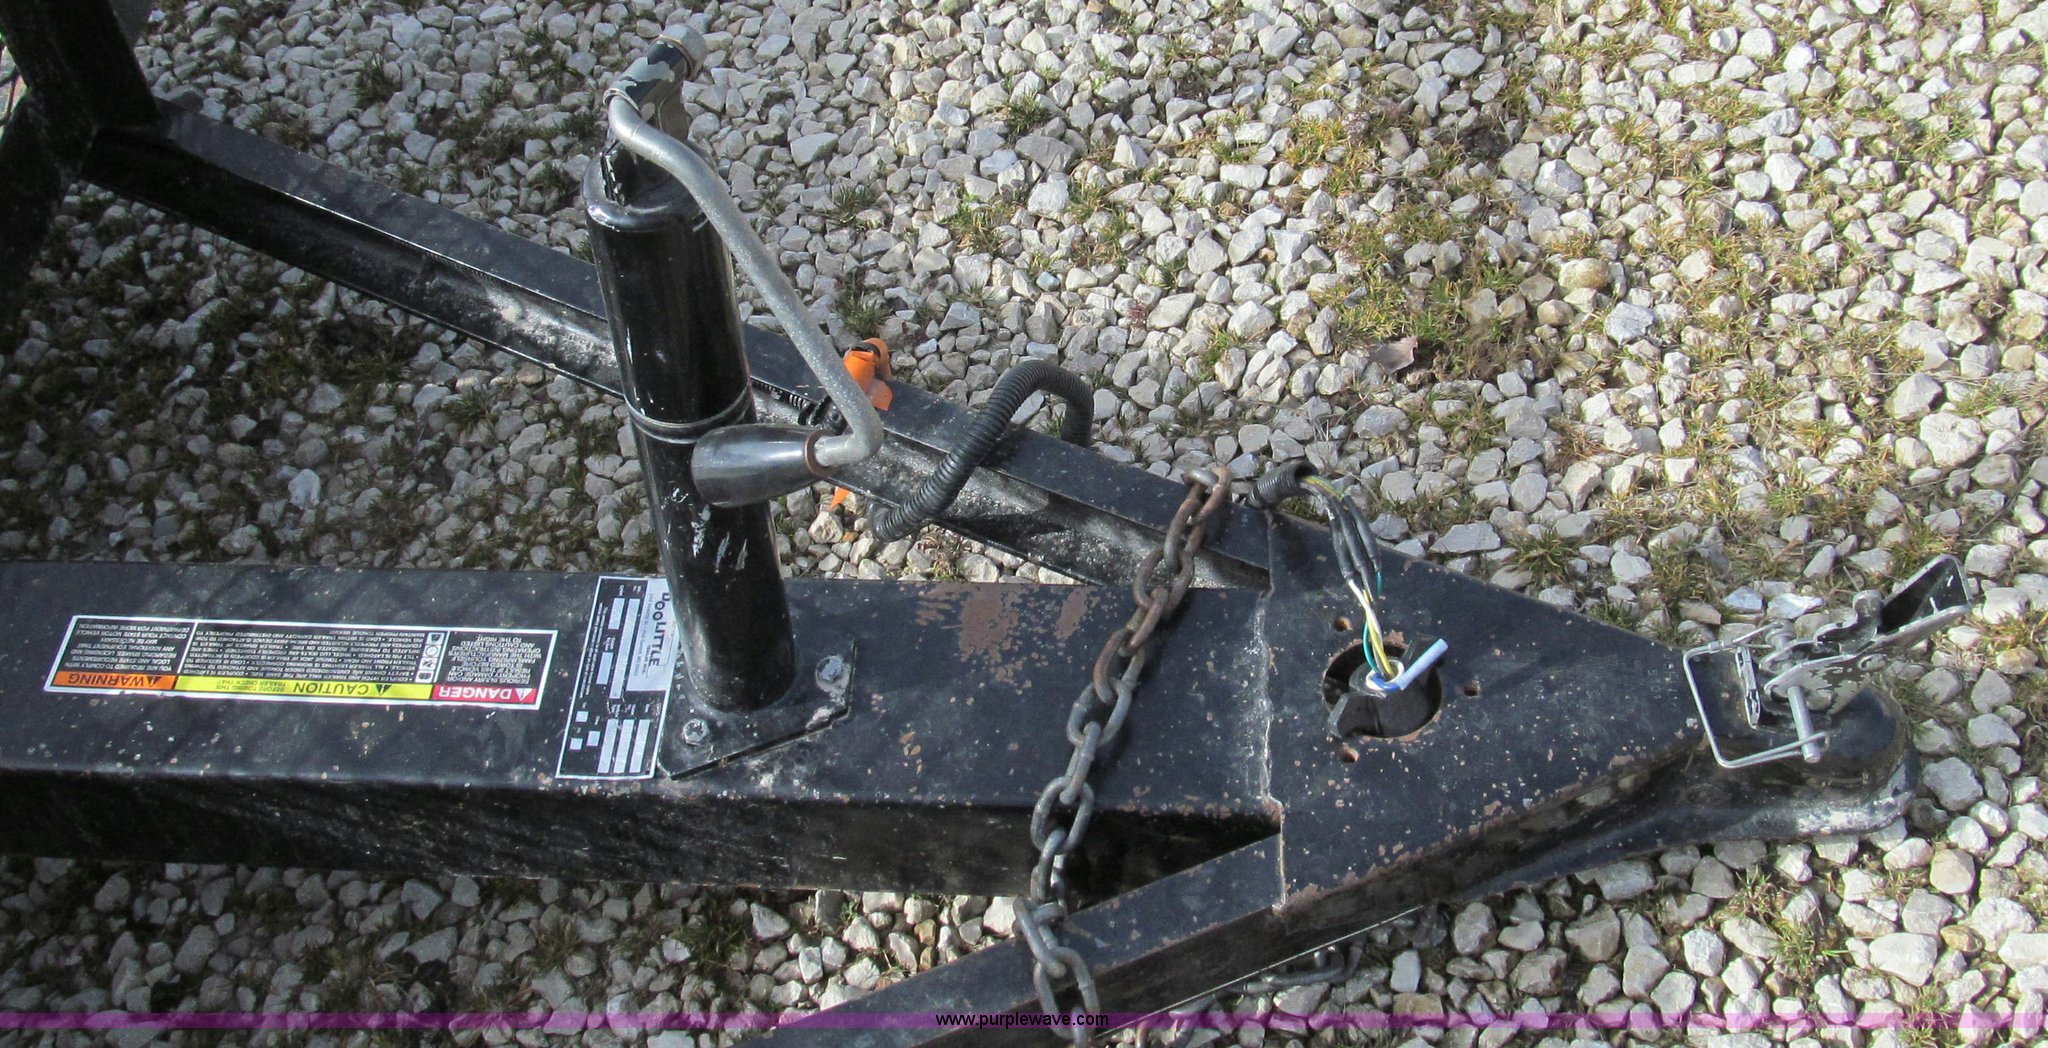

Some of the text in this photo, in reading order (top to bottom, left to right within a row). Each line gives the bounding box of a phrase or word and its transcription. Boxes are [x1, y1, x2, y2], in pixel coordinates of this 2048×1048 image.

[68, 674, 144, 686] WARNING
[293, 682, 369, 695] CAUTION
[439, 686, 512, 699] DANGER
